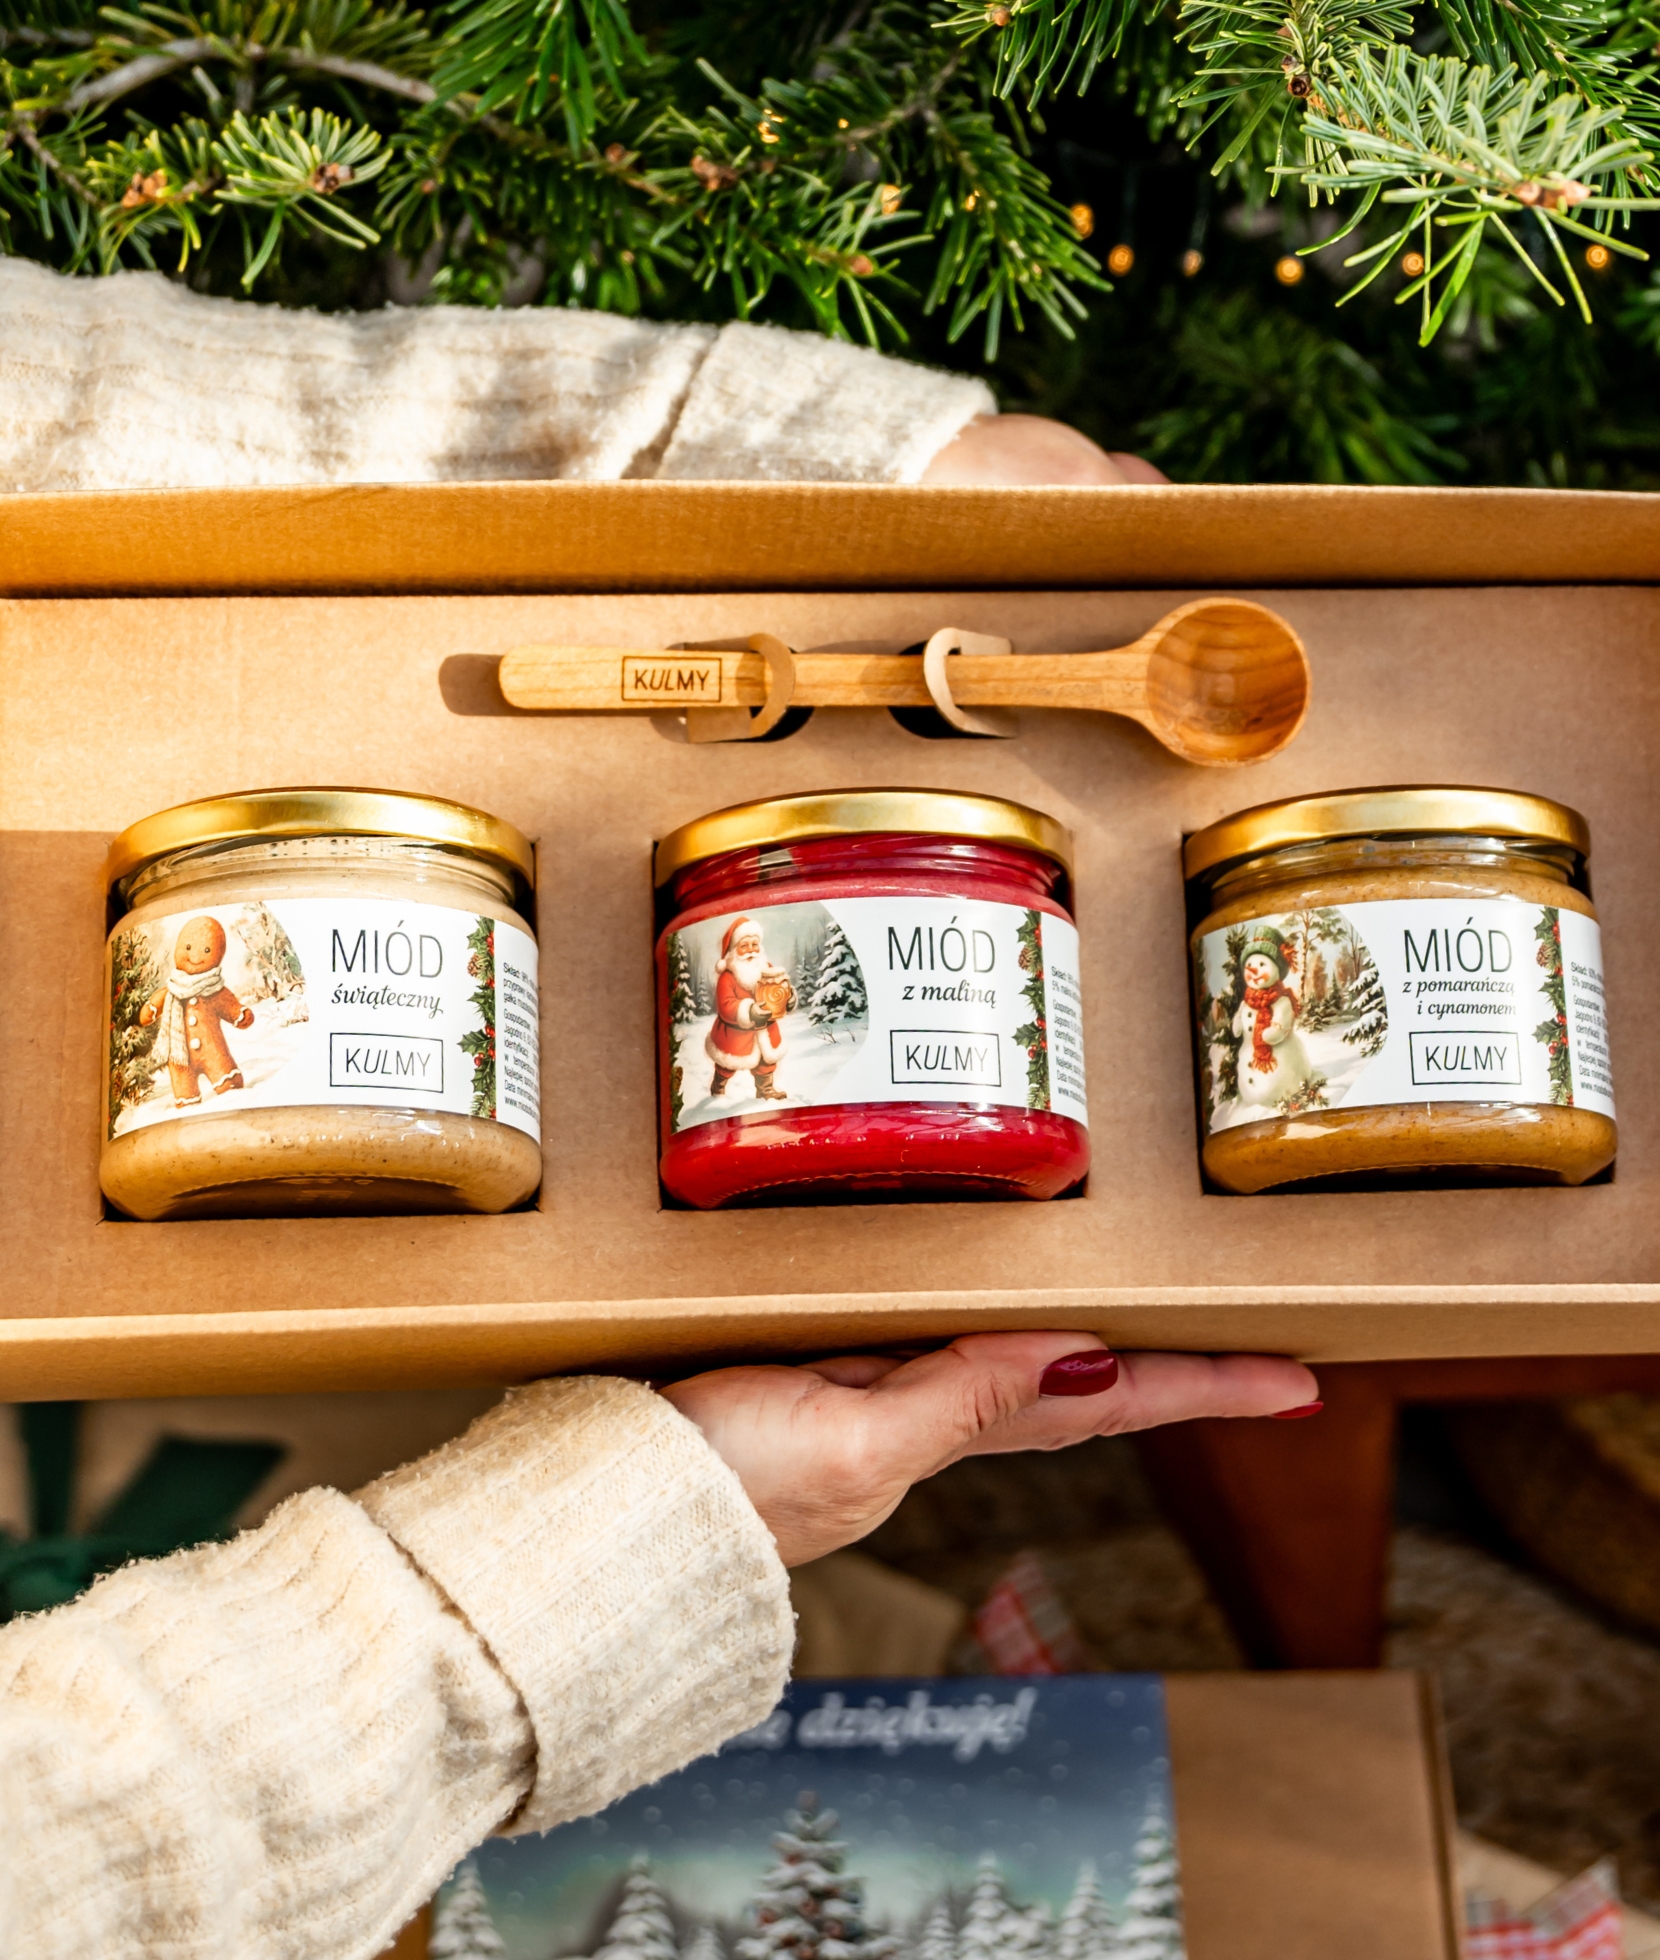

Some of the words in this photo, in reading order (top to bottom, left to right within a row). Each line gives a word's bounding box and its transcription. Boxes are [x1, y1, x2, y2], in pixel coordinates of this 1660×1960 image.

[634, 668, 710, 692] KULMY
[331, 919, 443, 978] MIÓD
[888, 915, 996, 973] MIÓD
[1403, 916, 1513, 973] MIÓD
[330, 982, 444, 1020] świąteczny
[902, 984, 913, 1001] z
[920, 979, 997, 1009] maliną
[1402, 981, 1412, 994] z
[1416, 975, 1515, 998] pomarańczą
[1417, 999, 1423, 1015] i
[1427, 1000, 1517, 1020] cynamonem
[345, 1047, 431, 1077] KULMY
[905, 1043, 991, 1072] KULMY
[1425, 1044, 1509, 1072] KULMY
[798, 1687, 1038, 1763] dziękuję!
